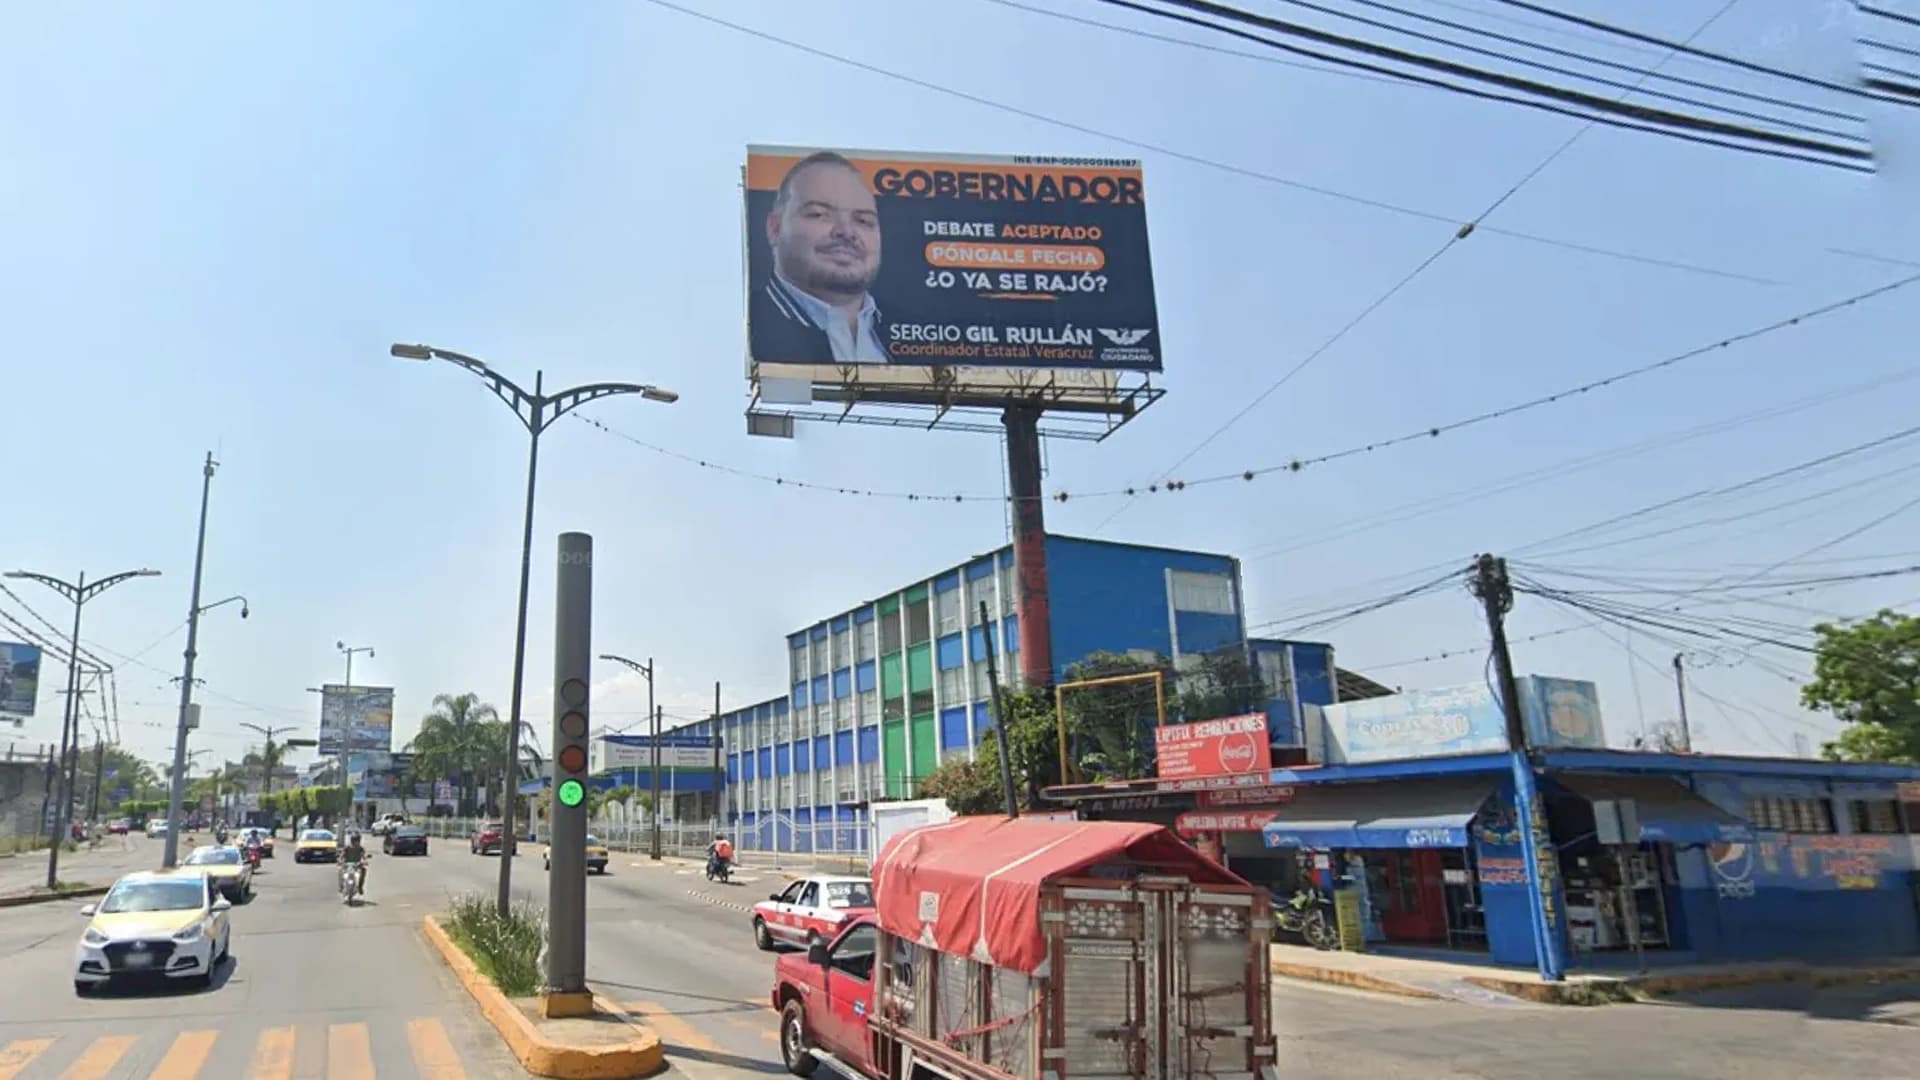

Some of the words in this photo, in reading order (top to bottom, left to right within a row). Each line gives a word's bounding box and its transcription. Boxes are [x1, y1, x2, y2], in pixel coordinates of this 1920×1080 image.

[873, 168, 1142, 204] GOBERNADOR
[923, 221, 995, 237] DEBATE
[1002, 224, 1102, 240] ACEPTADO
[933, 243, 1025, 264] PÓNGALE
[1033, 250, 1098, 265] FECHA
[926, 271, 955, 288] ¿O
[962, 272, 992, 288] YA
[999, 274, 1028, 290] SE
[1034, 270, 1107, 292] RAJÓ?
[890, 324, 961, 342] SERGIO
[966, 326, 999, 342] GIL
[1006, 323, 1093, 345] RULLÁN
[889, 341, 981, 357] Coordinador
[984, 344, 1030, 358] Estatal
[1034, 345, 1094, 360] Veracruz
